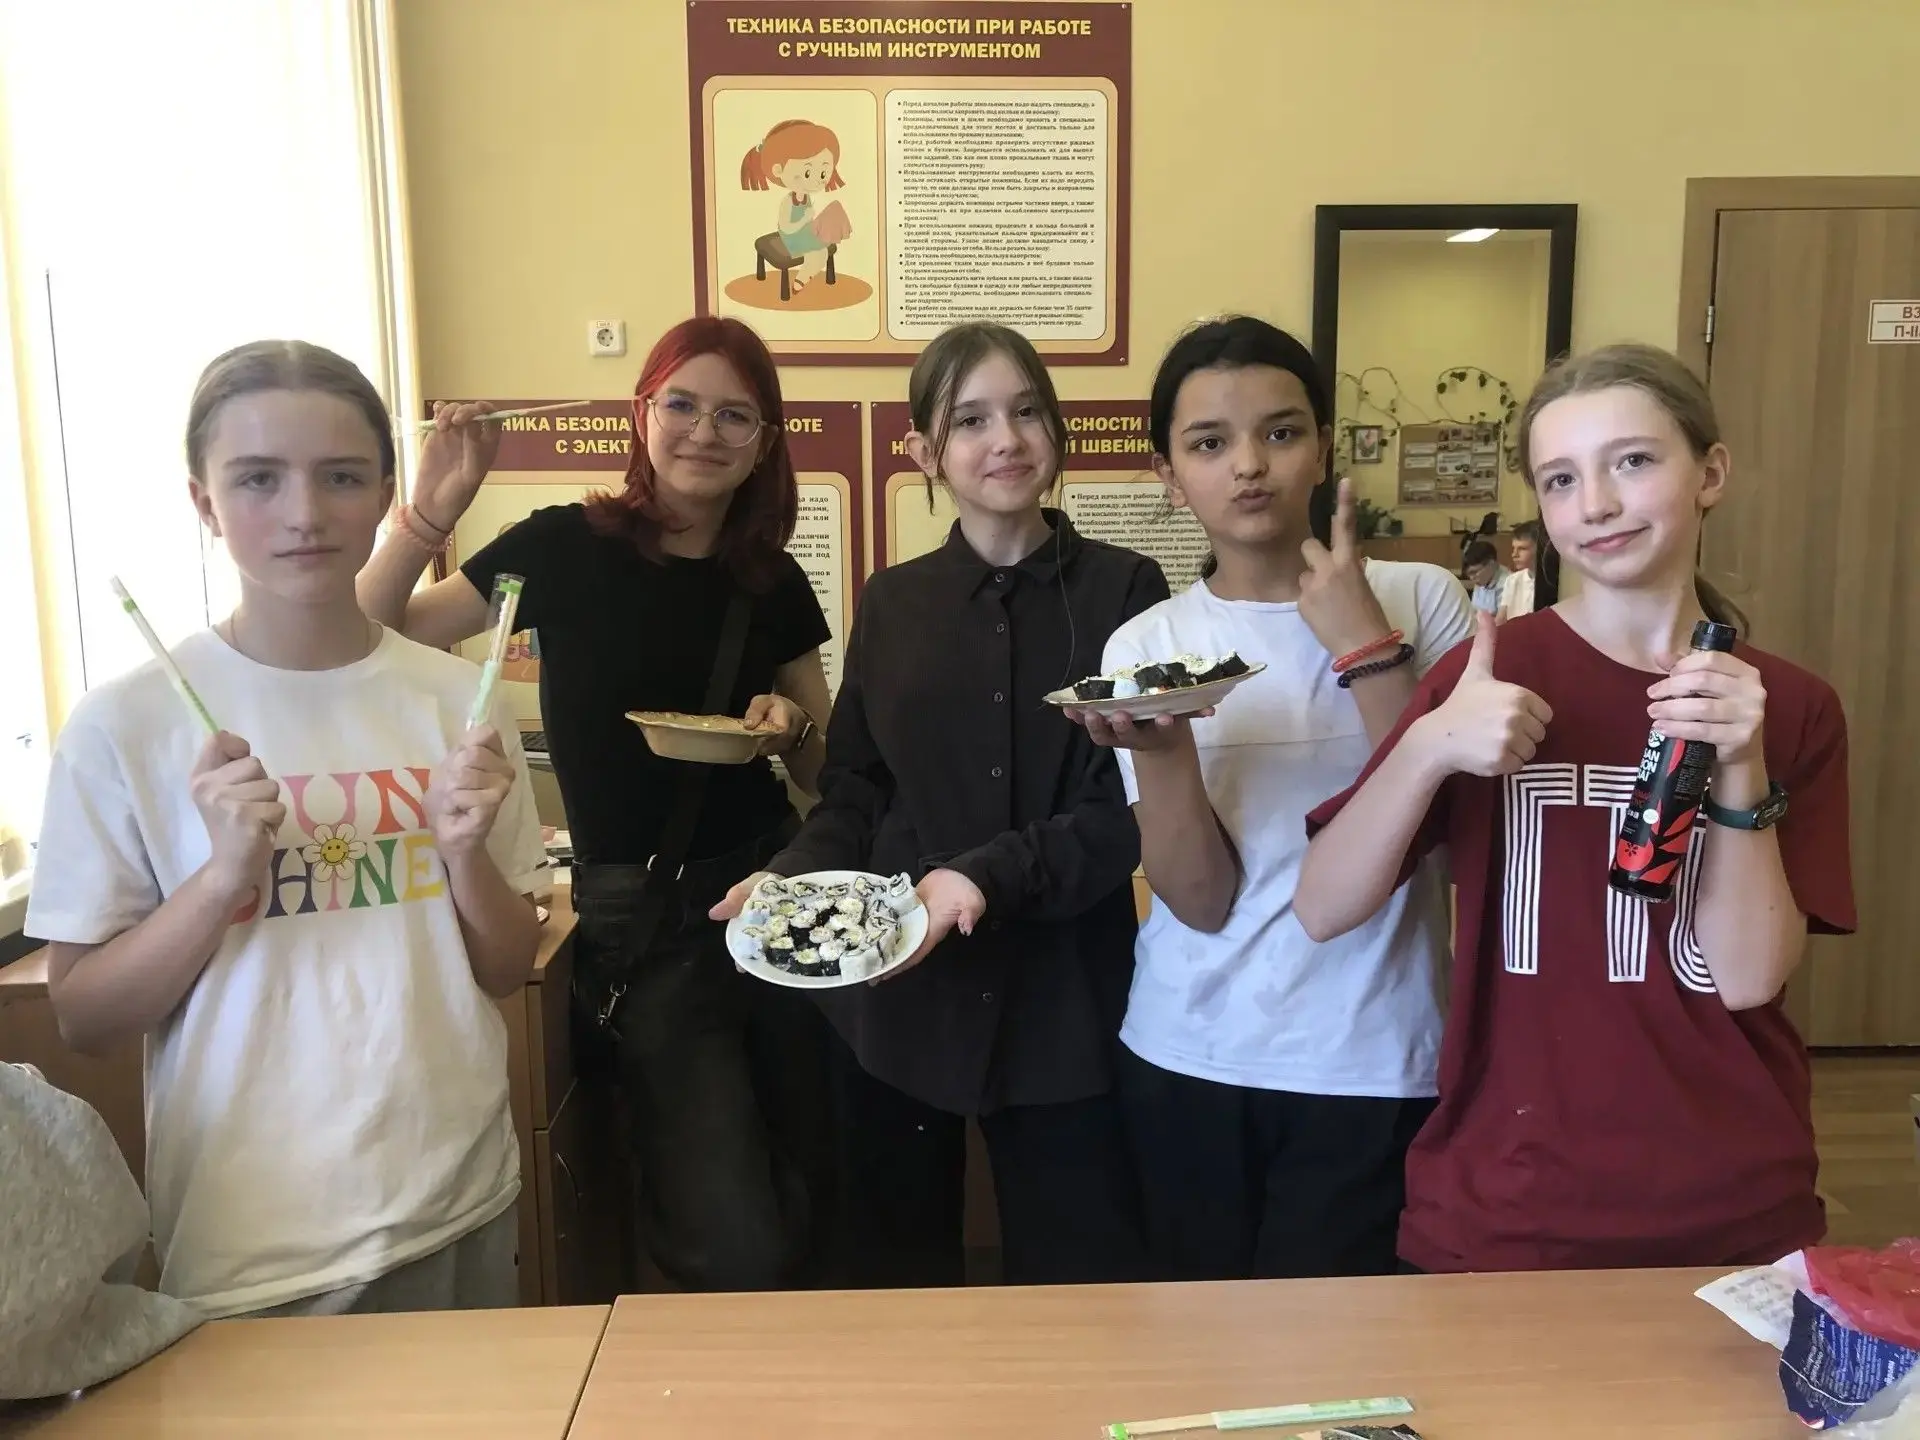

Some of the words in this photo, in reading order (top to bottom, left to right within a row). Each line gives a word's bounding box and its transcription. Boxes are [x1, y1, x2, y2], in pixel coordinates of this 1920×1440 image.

[727, 18, 813, 34] ТЕХНИКА
[820, 18, 970, 35] БЕЗОПАСНОСТИ
[976, 19, 1014, 35] ПРИ
[1020, 19, 1091, 35] РАБОТЕ
[778, 42, 791, 57] С
[797, 42, 882, 58] РУЧНЫМ
[888, 42, 1041, 58] ИНСТРУМЕНТОМ
[502, 417, 550, 431] НИКА
[556, 416, 631, 431] БЕЗОПА
[784, 418, 822, 433] ОТЕ
[556, 440, 568, 454] С
[573, 440, 631, 454] ЭЛЕКТ
[281, 767, 431, 840] UN
[229, 834, 445, 925] HINE
